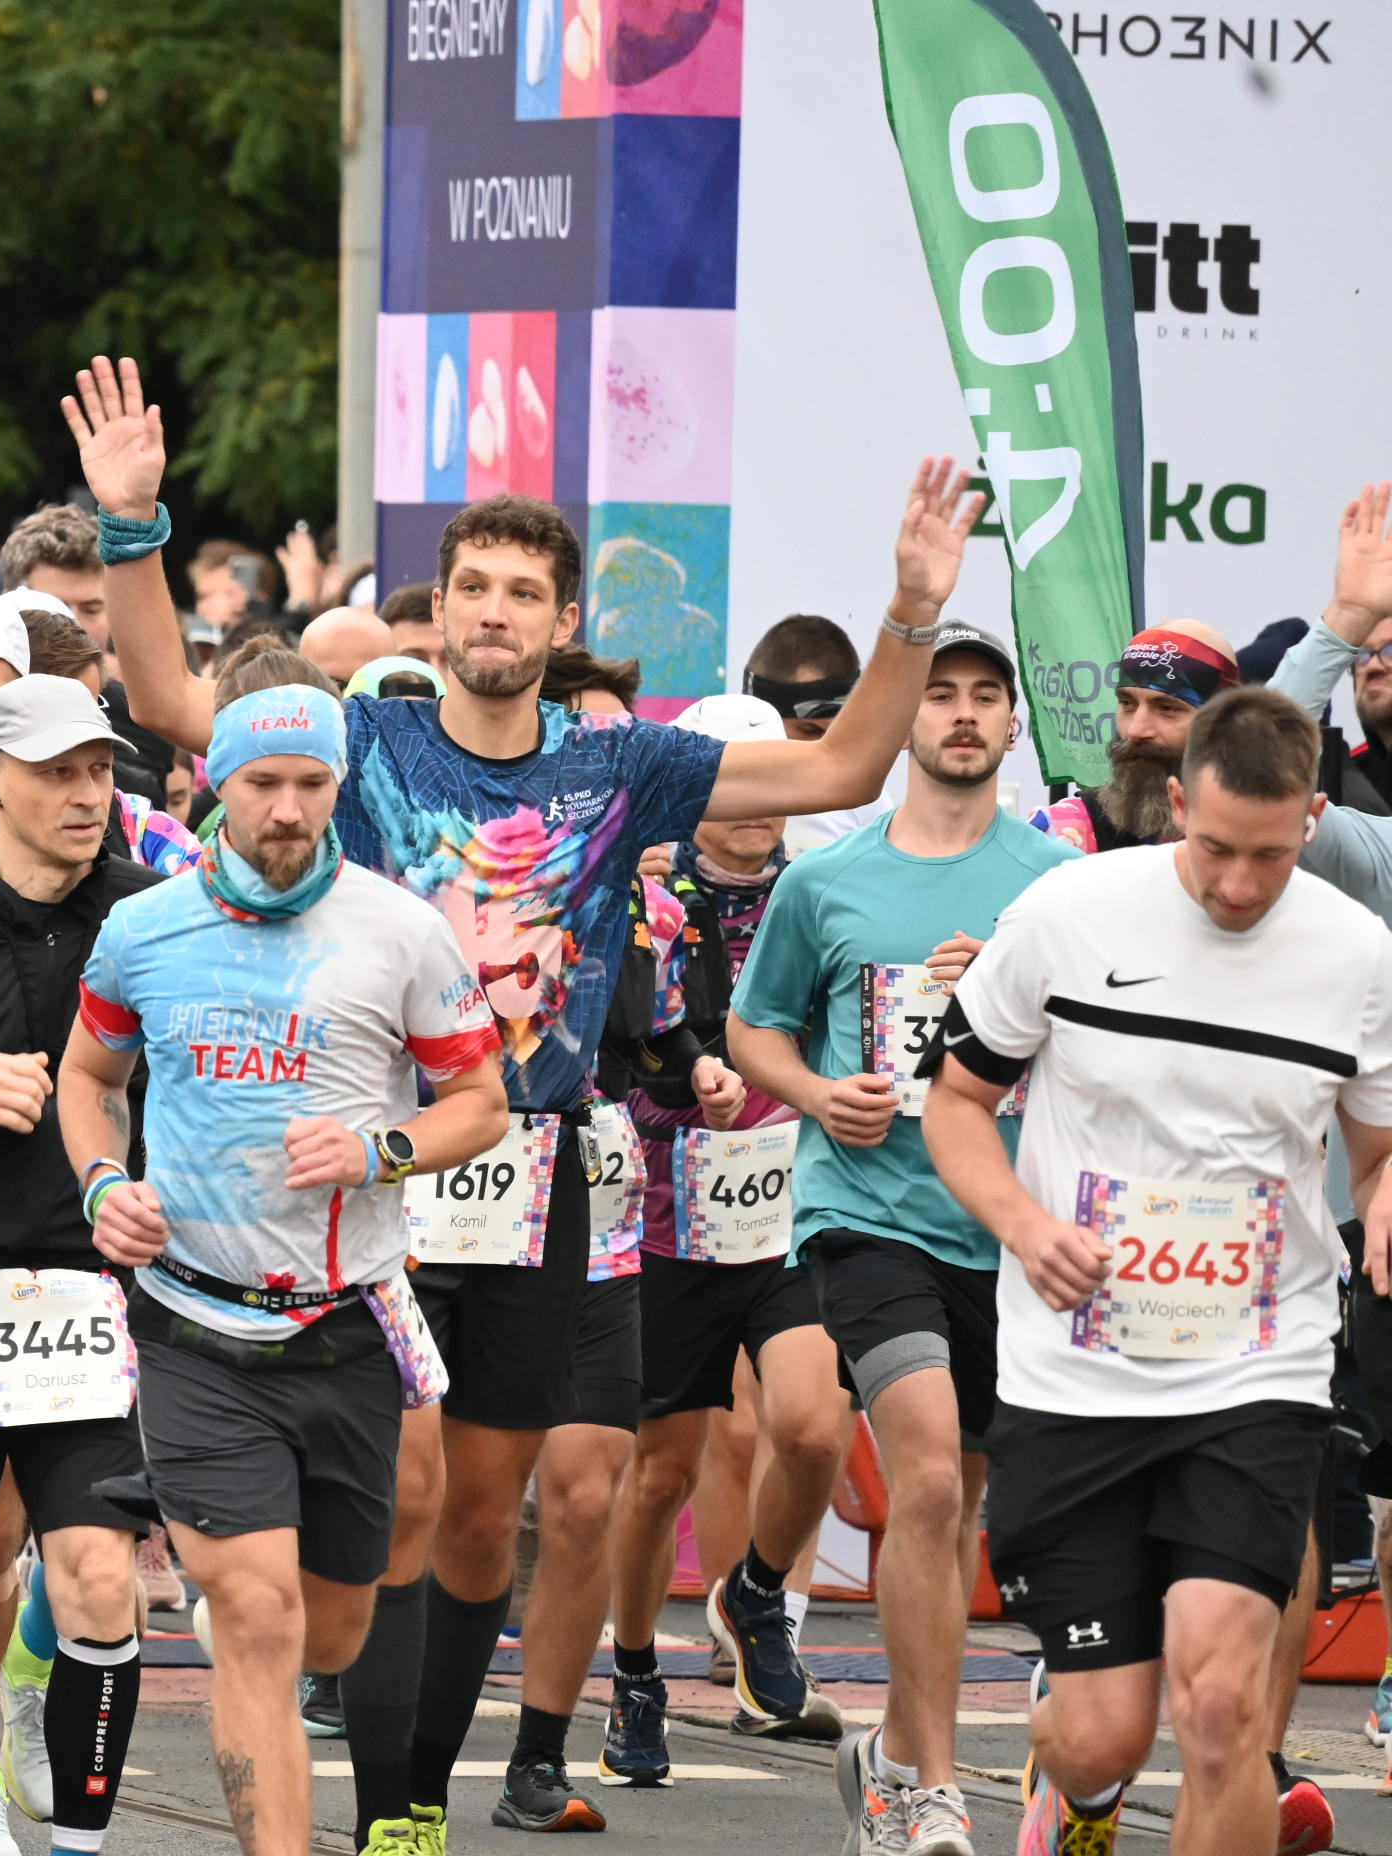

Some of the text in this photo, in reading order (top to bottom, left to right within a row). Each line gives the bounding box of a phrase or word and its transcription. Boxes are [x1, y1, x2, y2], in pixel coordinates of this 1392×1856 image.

[407, 0, 507, 62] BIEGNIEMY
[448, 174, 572, 242] W POZNANIU
[1157, 326, 1261, 342] DRINK
[249, 716, 310, 734] TEAM
[563, 789, 592, 803] 45.PKO
[567, 803, 605, 821] SZCZECIN
[169, 1003, 332, 1050] HERNIK
[188, 1043, 309, 1084] TEAM
[435, 1162, 515, 1201] 1619
[450, 1214, 488, 1228] Kamil
[734, 1213, 780, 1232] Tomasz
[1116, 1236, 1250, 1287] 2643
[1138, 1299, 1225, 1321] Wojciech
[25, 1372, 89, 1389] Dariusz
[94, 1671, 114, 1772] COMPRESSPORT
